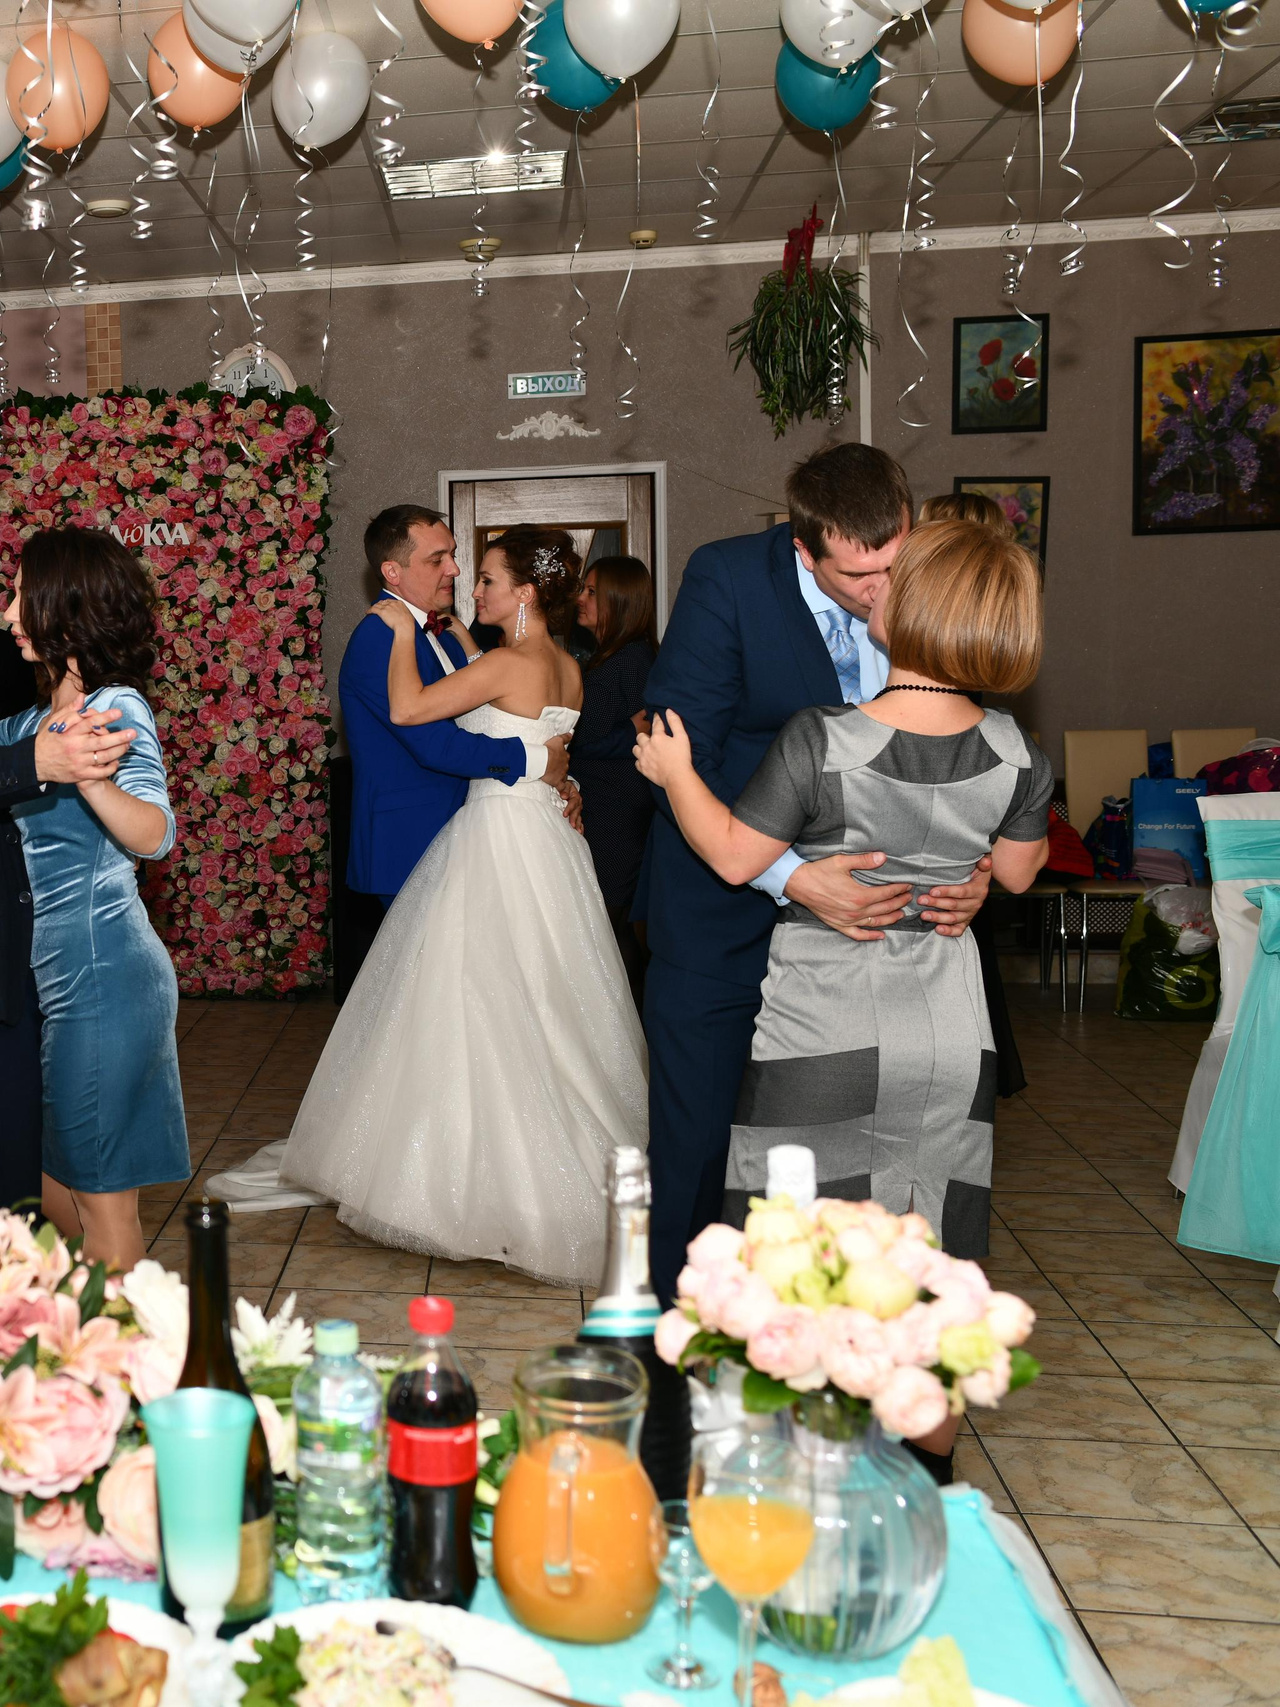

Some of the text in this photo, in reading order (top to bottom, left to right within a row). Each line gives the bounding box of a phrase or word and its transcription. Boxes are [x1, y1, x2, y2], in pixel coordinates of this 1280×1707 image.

[233, 371, 241, 379] 11
[263, 369, 268, 378] 1
[270, 381, 276, 390] 2
[516, 376, 580, 393] ВЫХОД
[1138, 823, 1162, 831] Change
